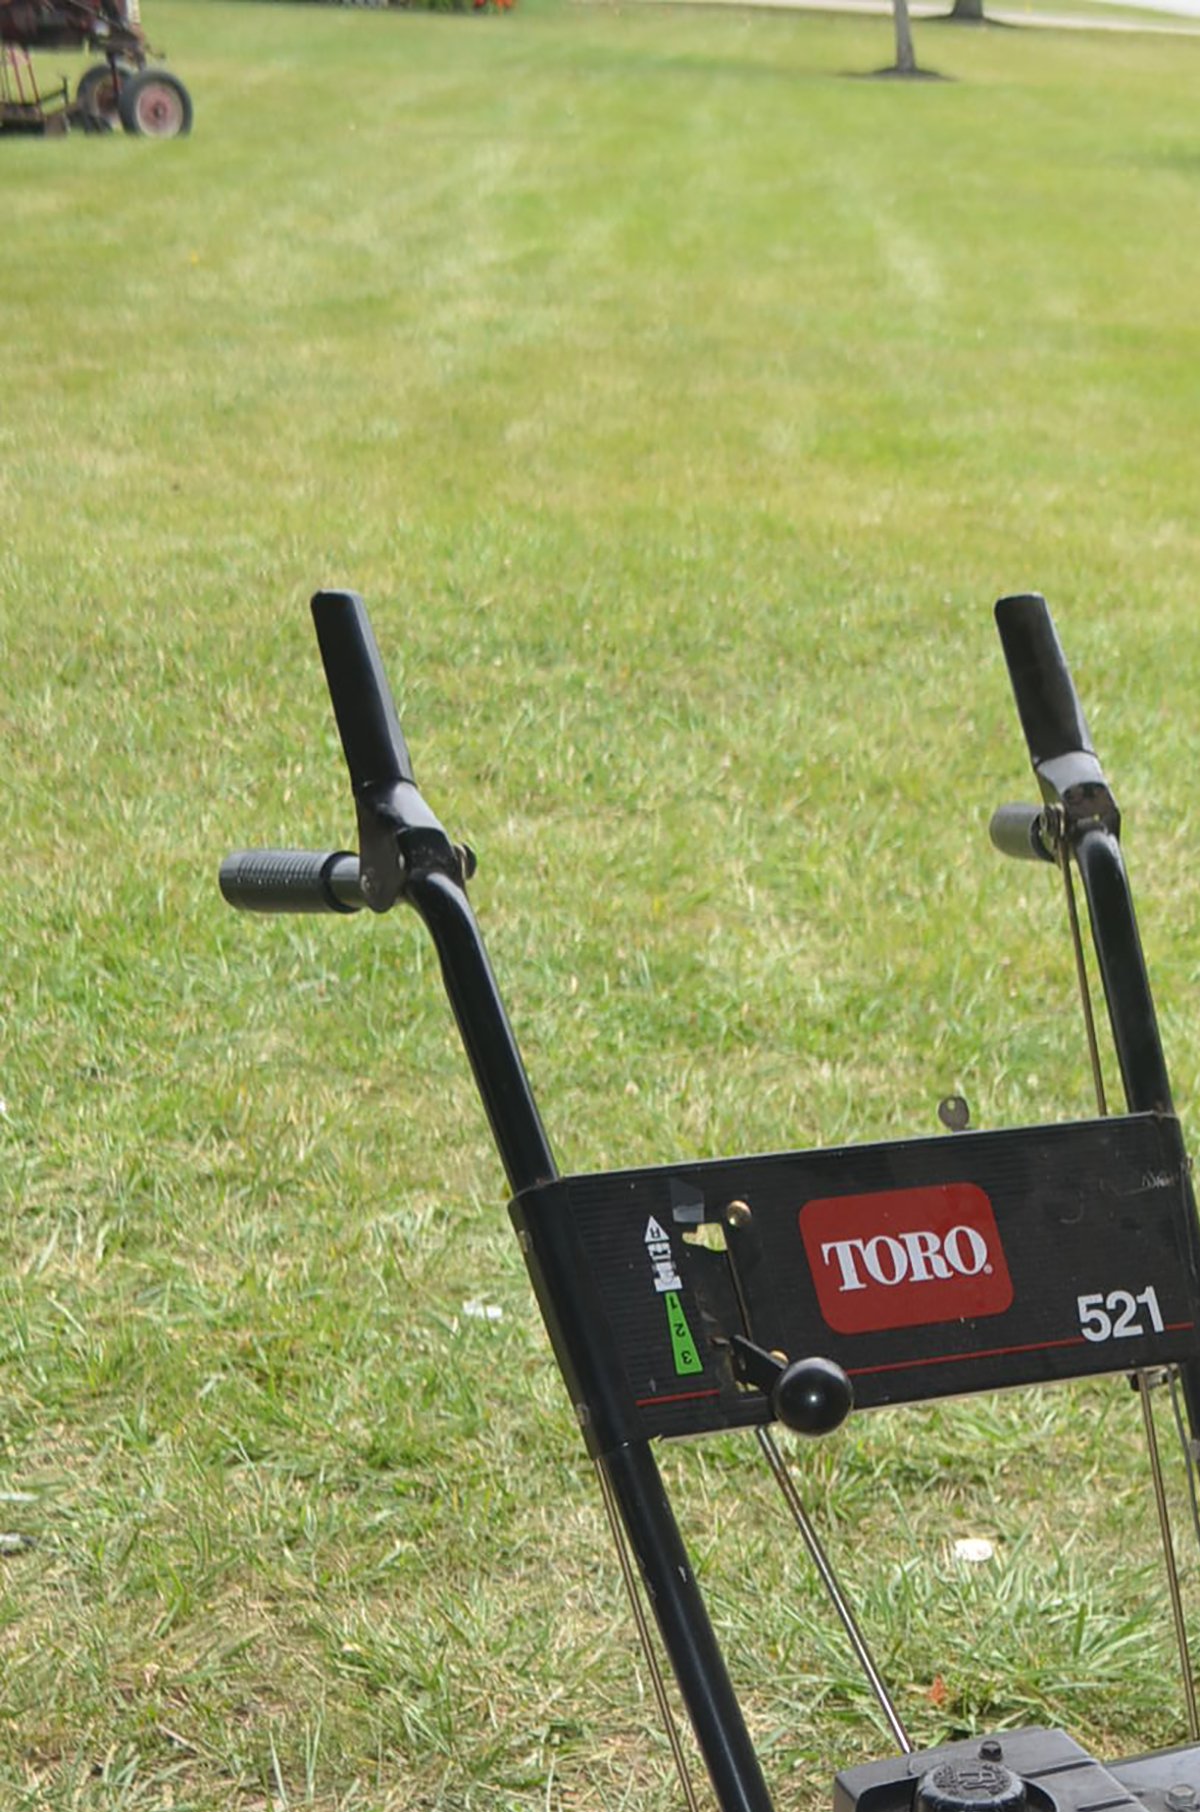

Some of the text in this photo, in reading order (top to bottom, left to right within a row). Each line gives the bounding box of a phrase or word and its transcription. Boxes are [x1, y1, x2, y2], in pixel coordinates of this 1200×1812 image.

[821, 1225, 988, 1292] TORO
[669, 1296, 678, 1310] 1
[1077, 1285, 1165, 1342] 521
[674, 1323, 686, 1338] 2
[681, 1350, 693, 1365] 3
